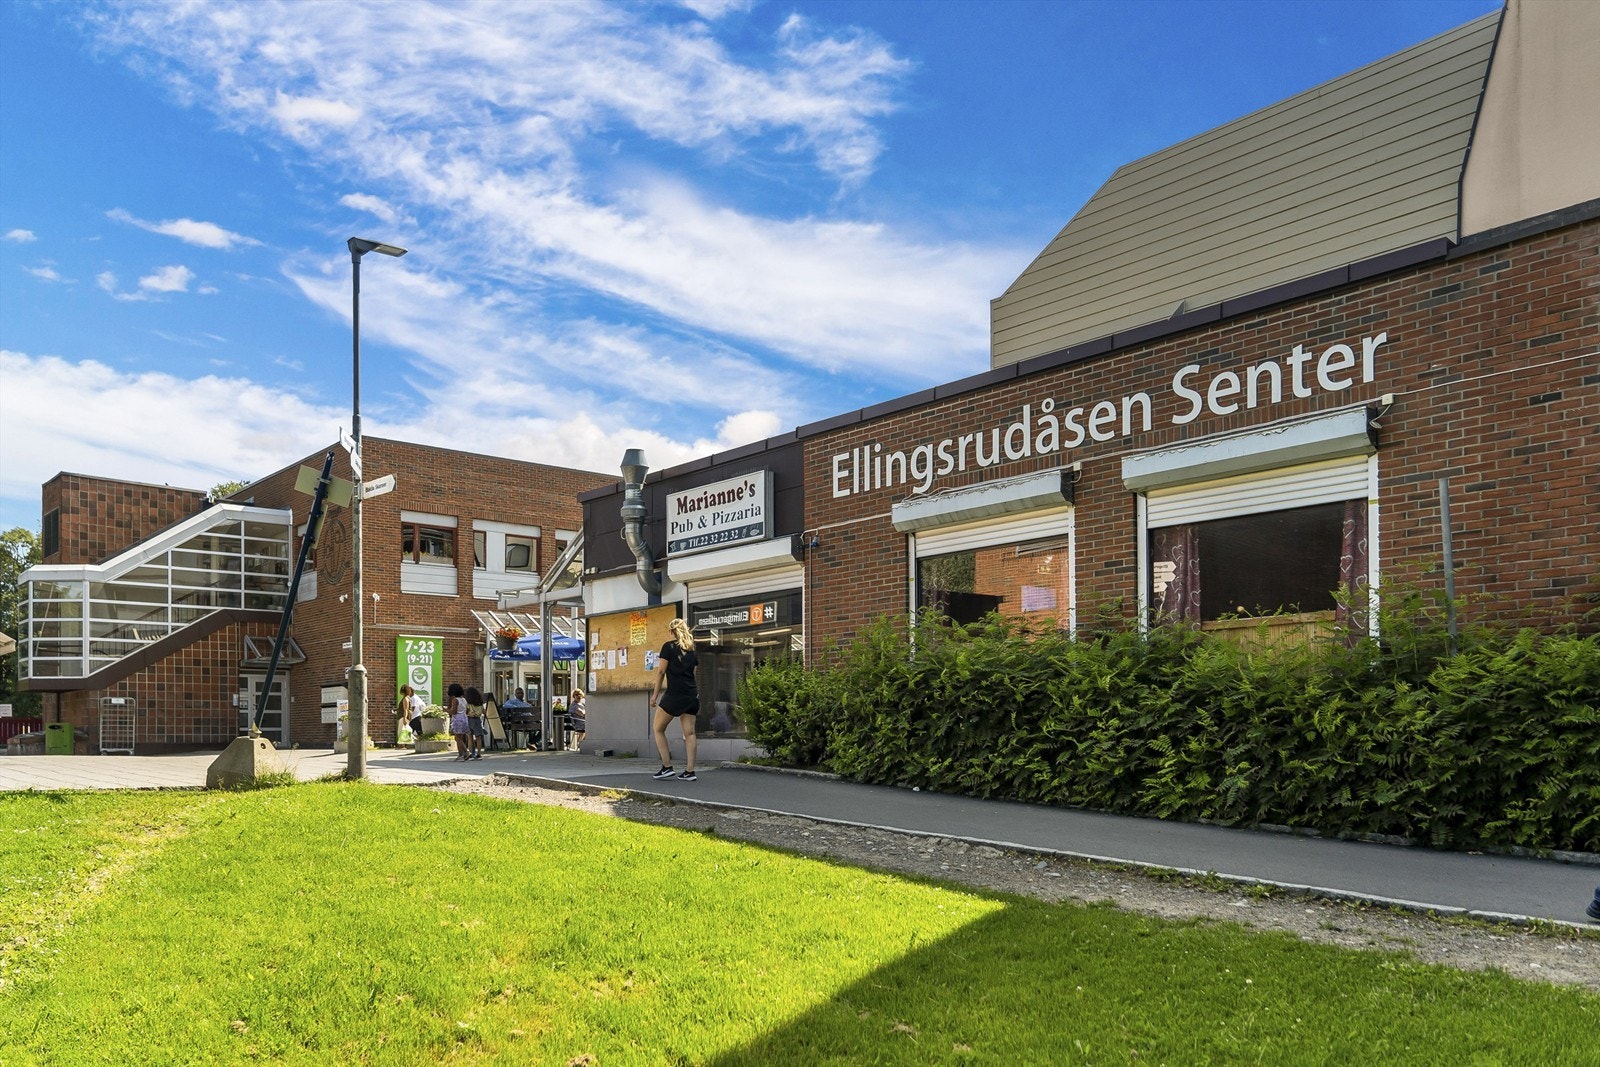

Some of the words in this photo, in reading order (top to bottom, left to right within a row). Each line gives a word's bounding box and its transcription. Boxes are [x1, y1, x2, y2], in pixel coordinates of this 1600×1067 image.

[832, 391, 1152, 498] Ellingsrudåsen
[1171, 331, 1388, 424] Senter
[676, 480, 756, 515] Marianne's
[670, 518, 693, 535] Pub
[697, 514, 707, 529] &
[712, 503, 761, 526] Pizzaria
[709, 533, 718, 544] 32
[719, 531, 728, 542] 22
[730, 529, 739, 540] 32
[404, 639, 435, 654] 7-23
[407, 654, 433, 664] (9-21)
